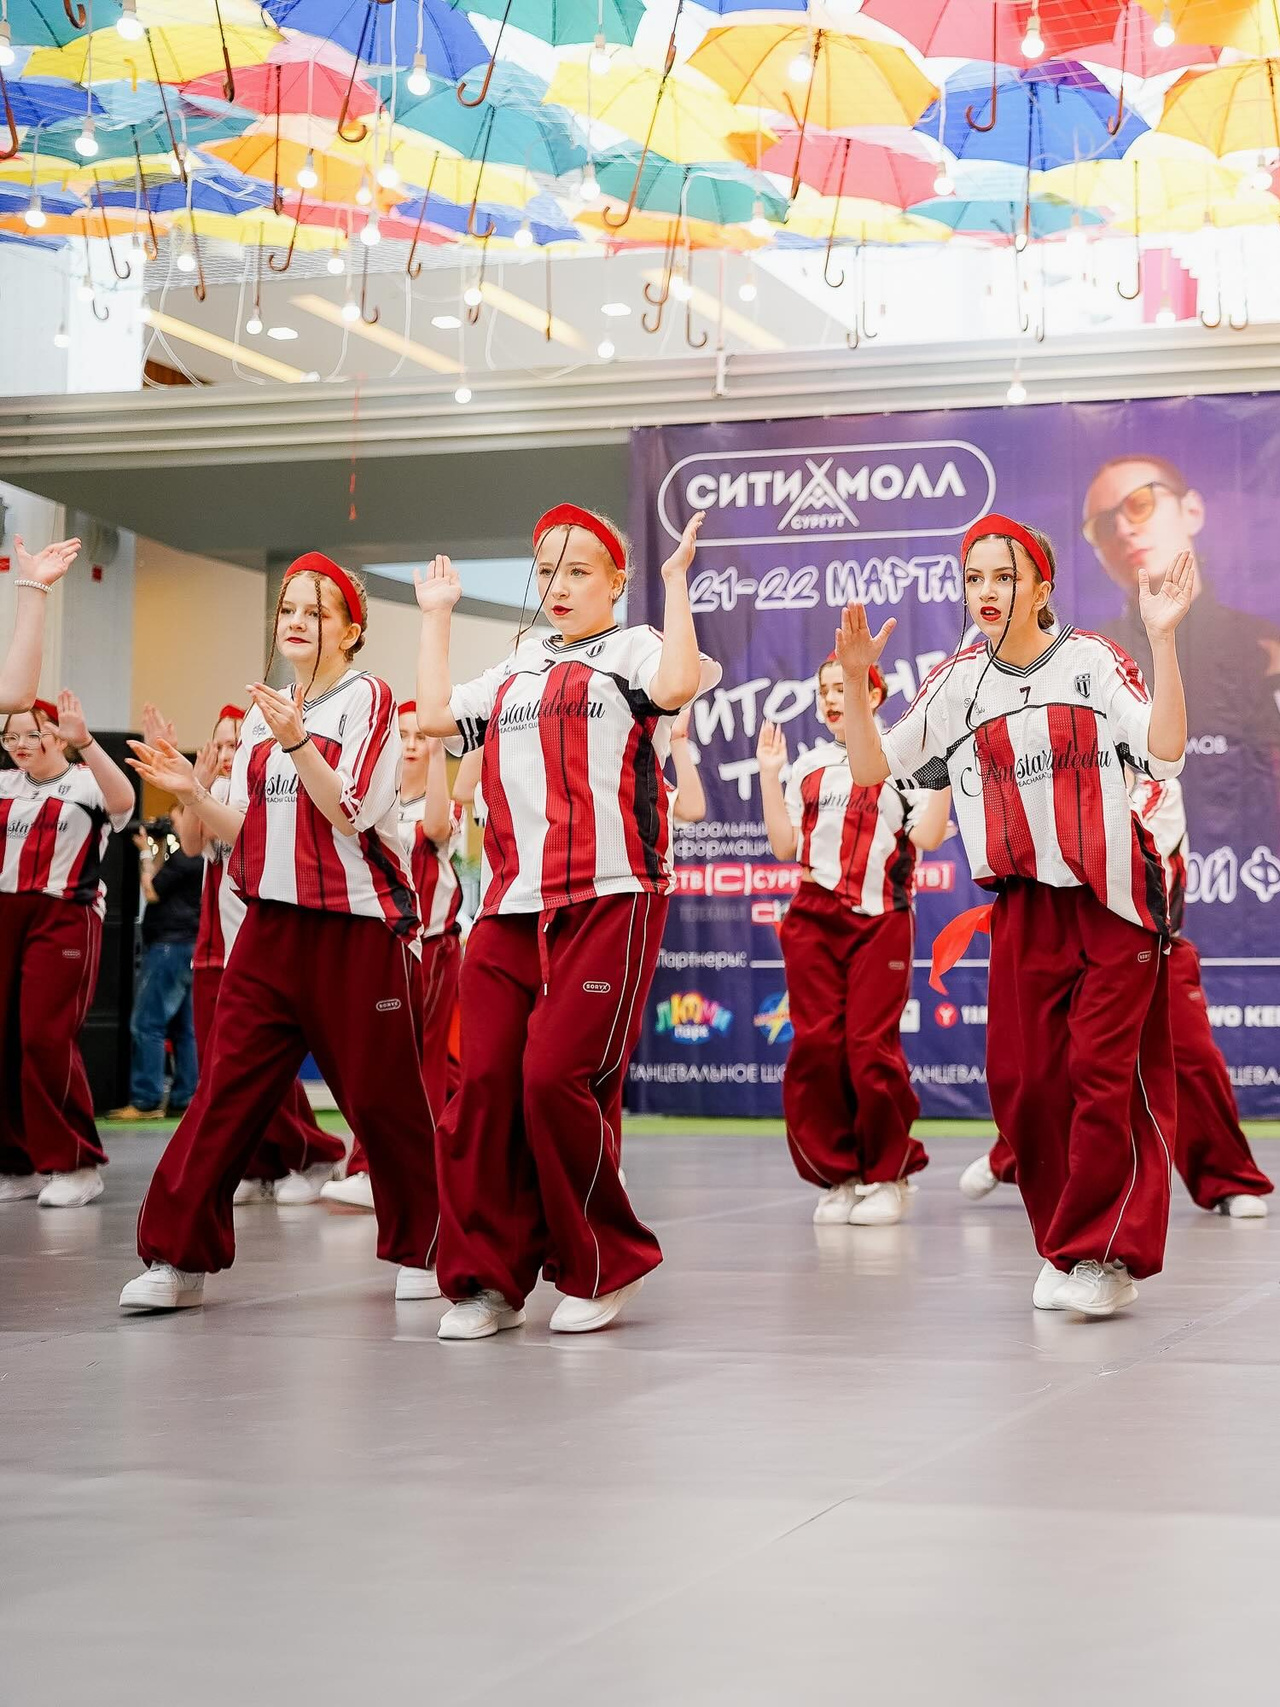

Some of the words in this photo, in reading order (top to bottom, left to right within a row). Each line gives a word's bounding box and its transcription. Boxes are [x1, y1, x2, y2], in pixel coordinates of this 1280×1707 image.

[685, 469, 804, 510] СИТИ
[836, 460, 967, 502] МОЛЛ
[790, 512, 847, 531] СУРГУТ
[689, 562, 821, 613] 21-22
[825, 553, 967, 606] МАРТА
[1019, 685, 1032, 705] 7
